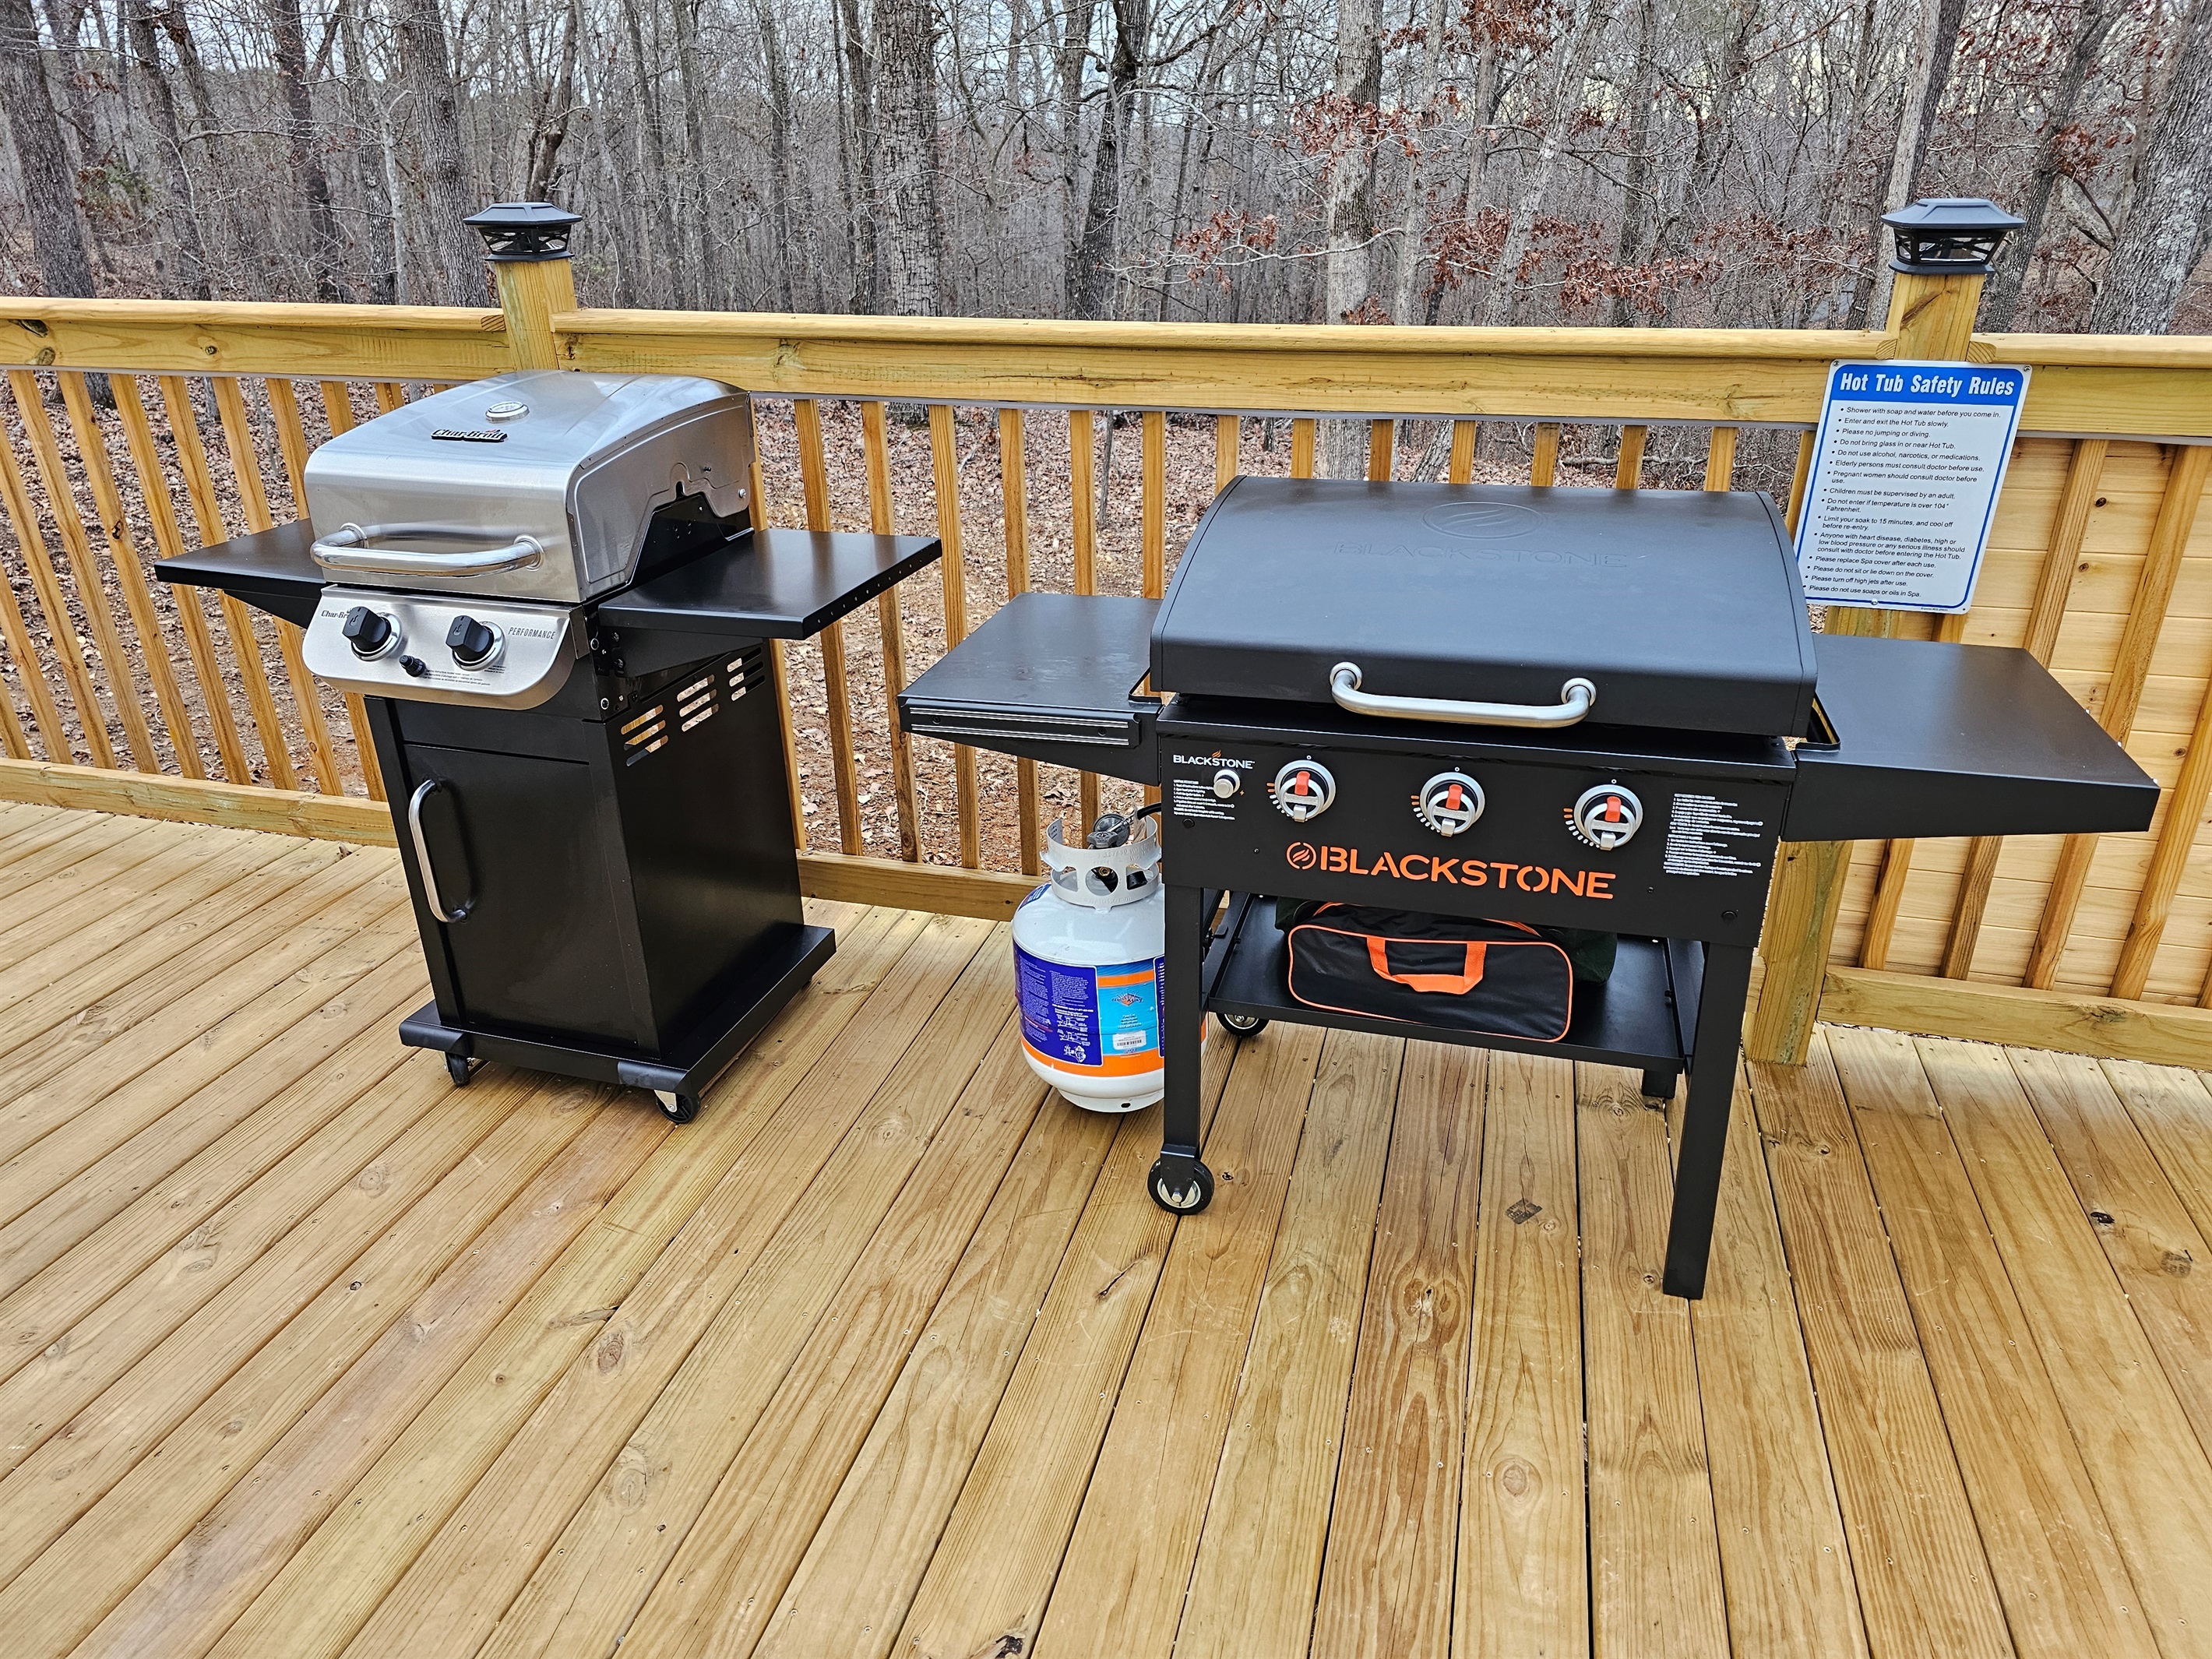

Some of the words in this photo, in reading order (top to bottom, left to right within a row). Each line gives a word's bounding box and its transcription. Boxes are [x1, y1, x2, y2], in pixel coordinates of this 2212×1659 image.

[1840, 372, 1869, 391] Hot
[1876, 374, 1904, 393] Tub
[1911, 375, 1963, 398] Safety
[1968, 376, 2015, 396] Rules
[1333, 541, 1628, 568] BLACKSTONE
[321, 610, 349, 618] Char-Br
[508, 627, 556, 639] PERFORMANCE
[1173, 754, 1254, 770] BLACKSTONE
[1320, 845, 1616, 900] BLACKSTONE
